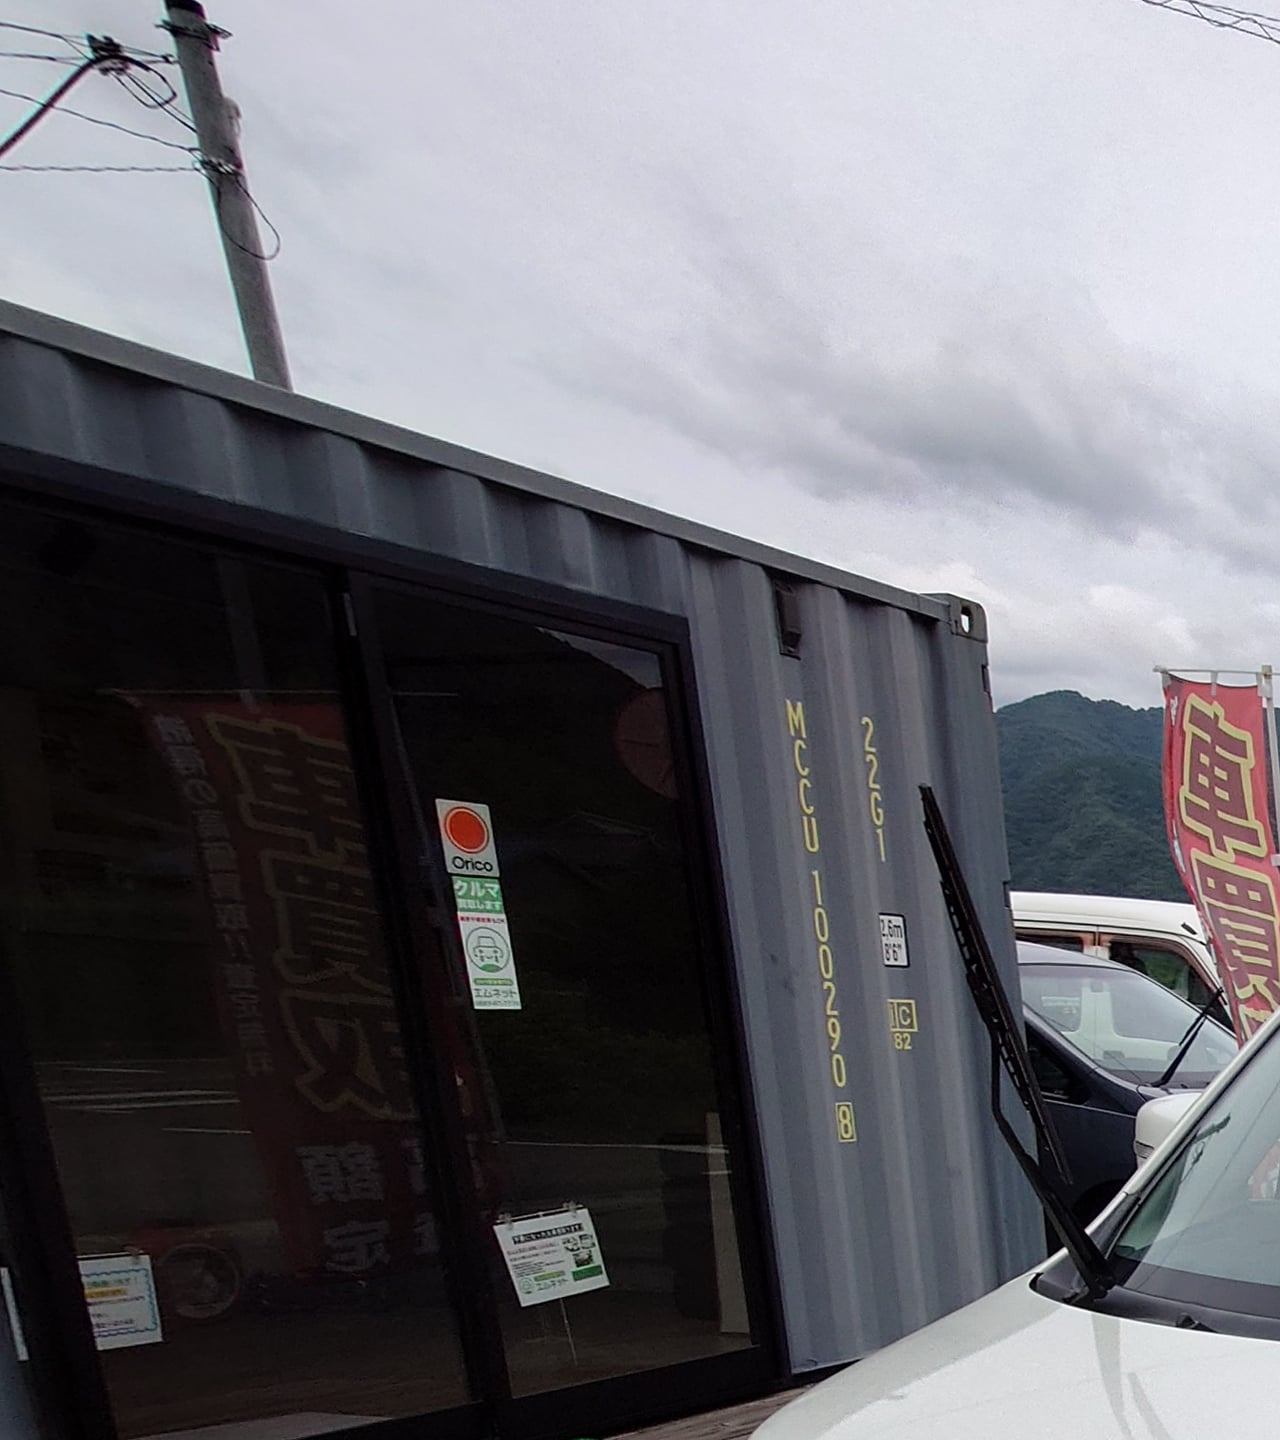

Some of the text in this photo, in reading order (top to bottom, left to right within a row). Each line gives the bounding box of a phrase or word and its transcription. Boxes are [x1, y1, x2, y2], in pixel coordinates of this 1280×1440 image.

[452, 856, 493, 872] Orico
[455, 881, 501, 898] クルマ
[785, 699, 855, 1140] MCCU 100290 8
[894, 1032, 912, 1051] 82
